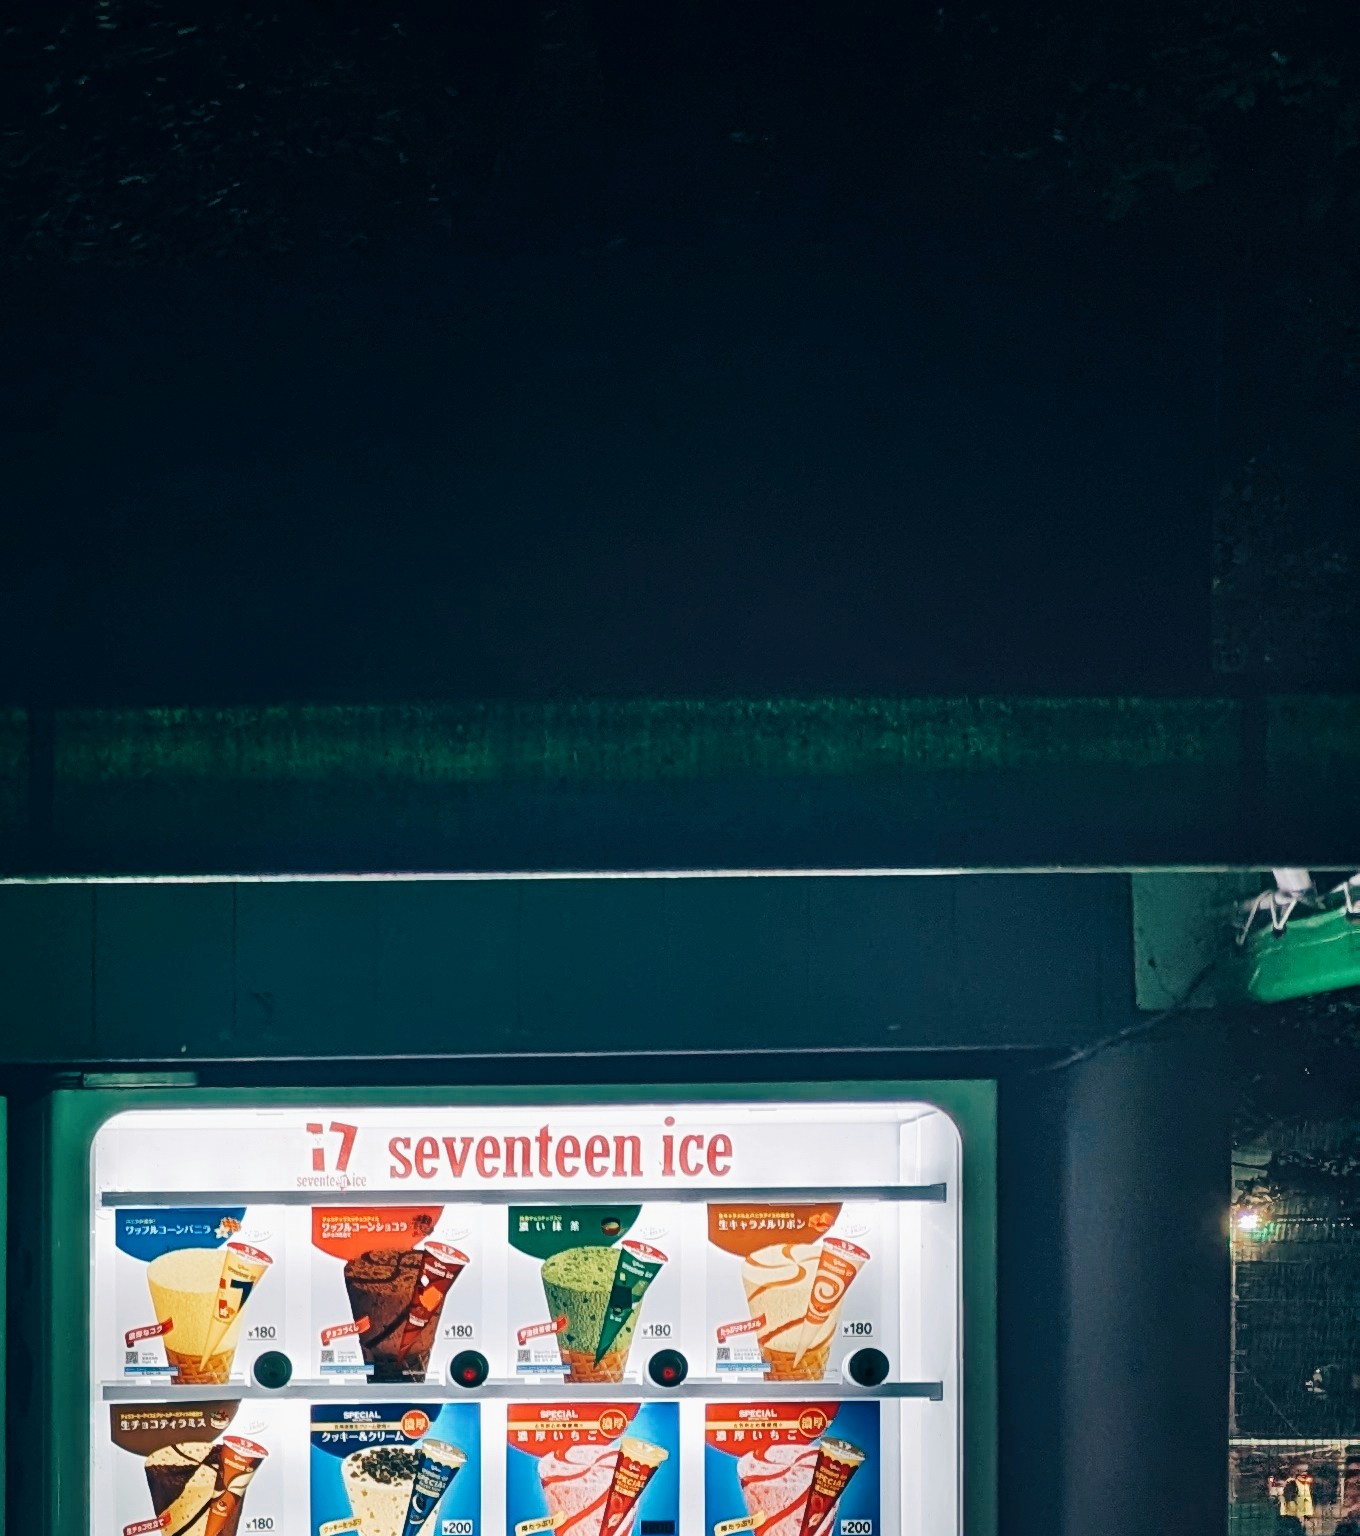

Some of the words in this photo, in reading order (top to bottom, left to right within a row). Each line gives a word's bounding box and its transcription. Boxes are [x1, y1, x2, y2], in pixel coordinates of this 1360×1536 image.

[389, 1124, 643, 1179] seventeen
[661, 1116, 733, 1178] ice
[125, 1224, 212, 1235] ワッフルコーンバニラ
[321, 1222, 407, 1233] ワッフルコーンショコラ
[717, 1219, 805, 1231] 生キャラメルリボン
[247, 1327, 276, 1339] ¥180
[445, 1326, 472, 1338] ¥180
[343, 1411, 380, 1419] SPECIAL
[120, 1419, 207, 1431] 生チョコティラミス
[404, 1418, 426, 1432] 濃厚
[321, 1431, 404, 1442] クッキー&クリーム
[517, 1431, 597, 1442] 濃厚いちご
[715, 1431, 797, 1442] 濃厚いちご
[443, 1523, 472, 1534] ¥200
[842, 1522, 871, 1535] ¥200
